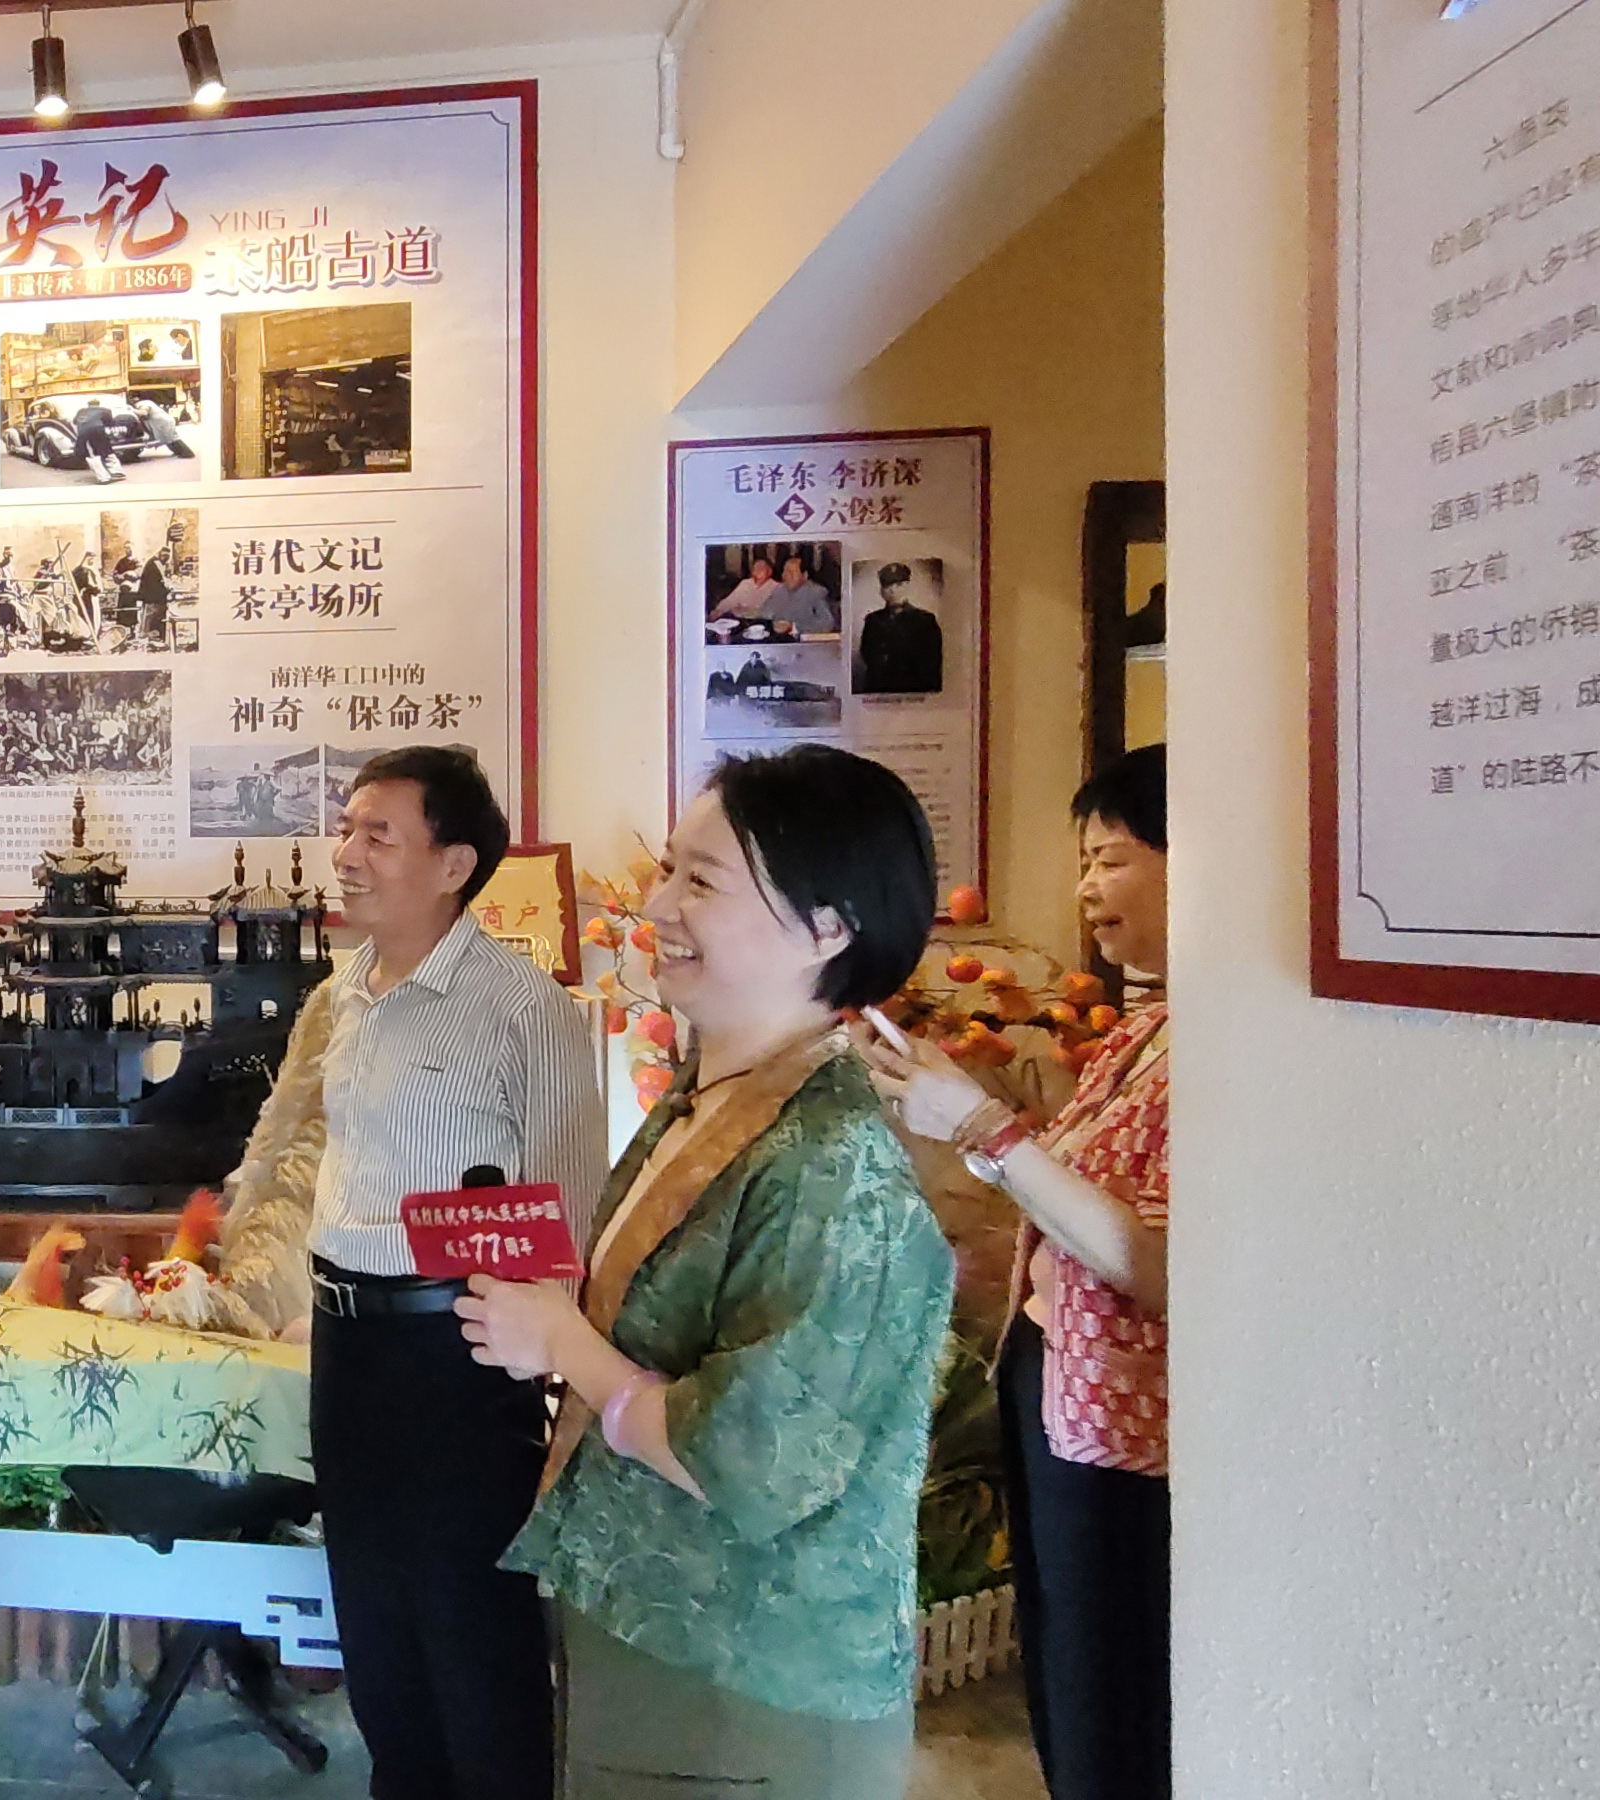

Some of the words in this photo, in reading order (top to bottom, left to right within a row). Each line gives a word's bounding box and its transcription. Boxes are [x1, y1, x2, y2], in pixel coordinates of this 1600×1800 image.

[209, 208, 286, 233] YING
[299, 206, 328, 228] JI
[725, 461, 817, 494] 毛泽东
[827, 457, 922, 490] 李济深
[783, 501, 806, 523] 与
[230, 536, 385, 576] 清代文记
[230, 582, 385, 620] 茶亭场所
[269, 662, 426, 689] 南洋华工口中的
[478, 900, 540, 930] 商户
